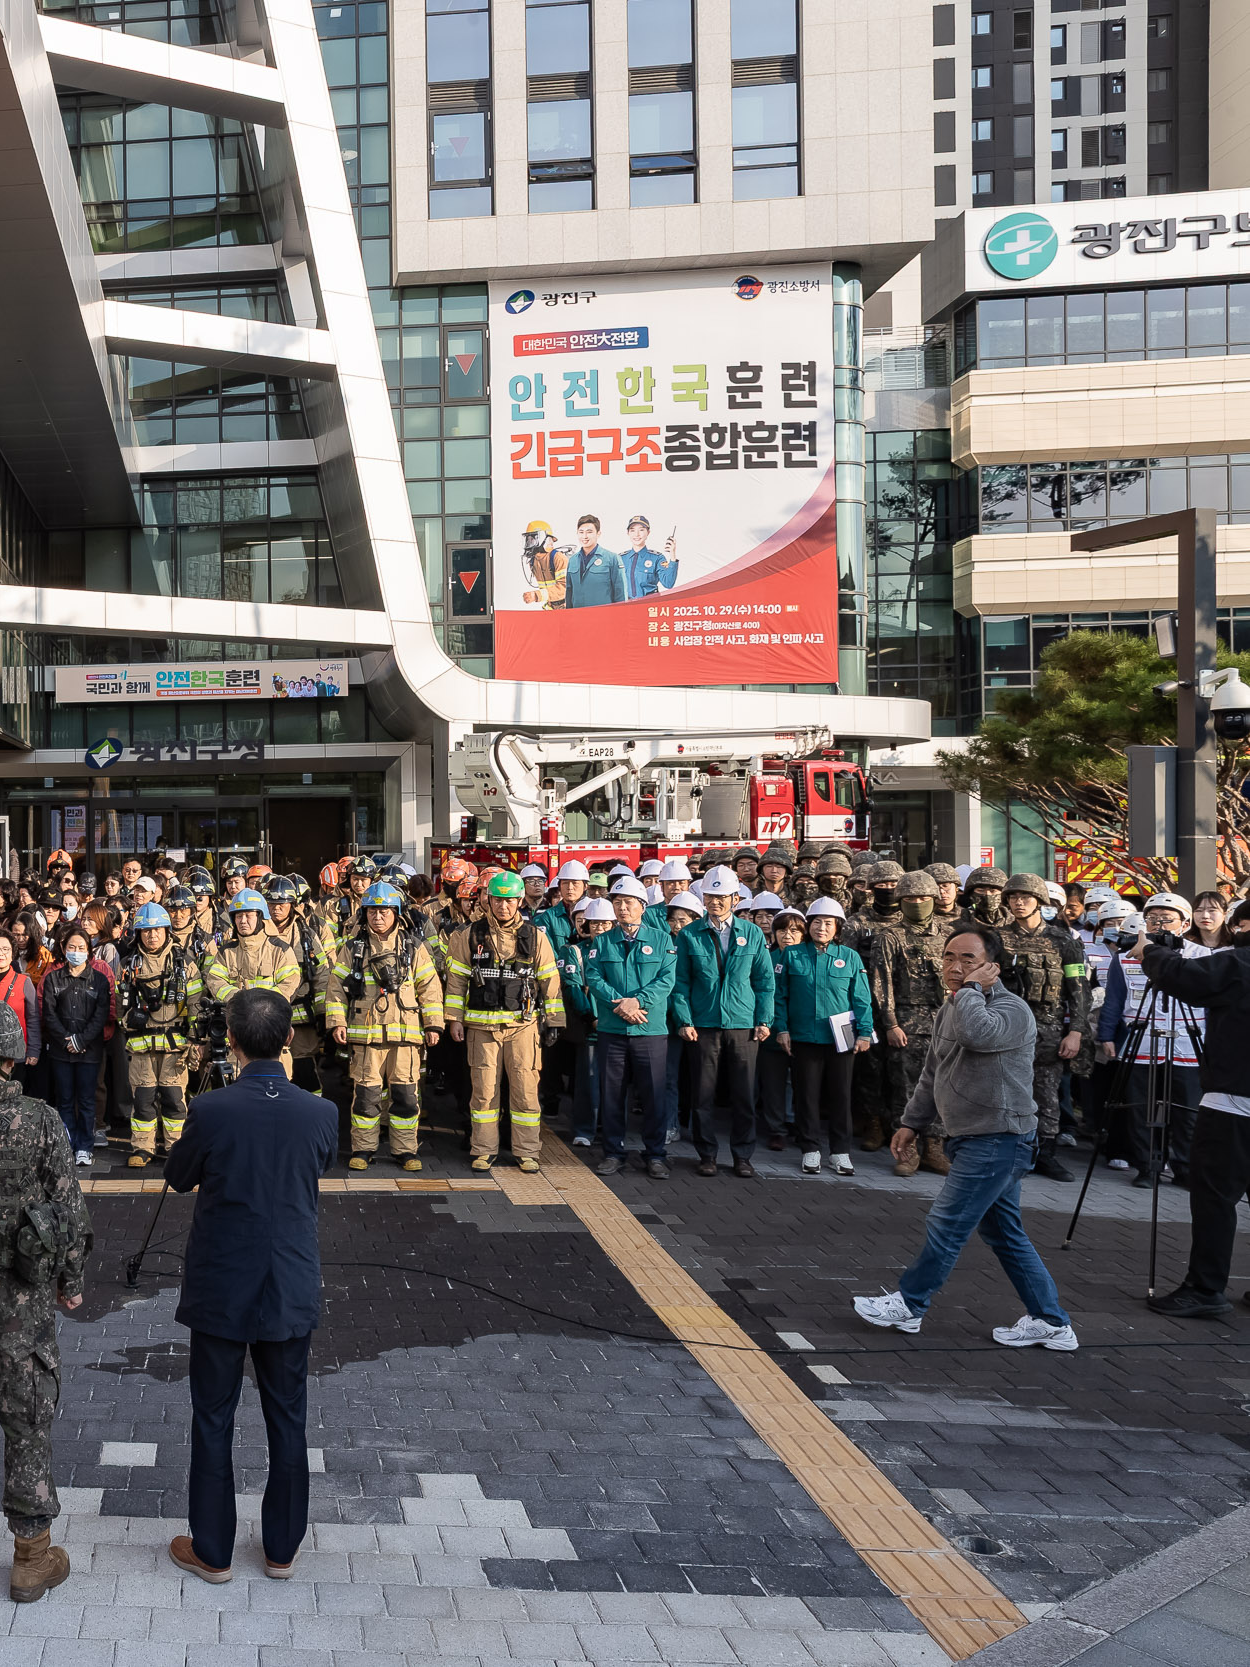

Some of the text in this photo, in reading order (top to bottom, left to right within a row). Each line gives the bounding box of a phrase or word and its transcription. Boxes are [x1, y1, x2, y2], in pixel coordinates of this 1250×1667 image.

[767, 279, 820, 294] 광진소방서
[541, 291, 597, 306] 광진구
[521, 331, 640, 351] 대한민국 안전大전환
[510, 421, 818, 479] 긴급구조종합훈련
[673, 606, 702, 617] 2025.
[703, 605, 718, 616] 10.
[752, 604, 782, 615] 14:00
[673, 635, 703, 647] 사업장
[704, 634, 724, 646] 인적
[725, 634, 748, 646] 사고,
[749, 633, 769, 645] 화재
[770, 633, 782, 645] 및
[782, 633, 802, 645] 인파
[803, 633, 825, 644] 사고
[86, 682, 123, 695] 국민과
[125, 681, 151, 694] 함께
[155, 669, 261, 688] 안전한국훈련
[129, 738, 265, 764] 광진구청
[588, 748, 614, 757] EAP28
[483, 786, 498, 796] 119
[761, 814, 791, 833] 119
